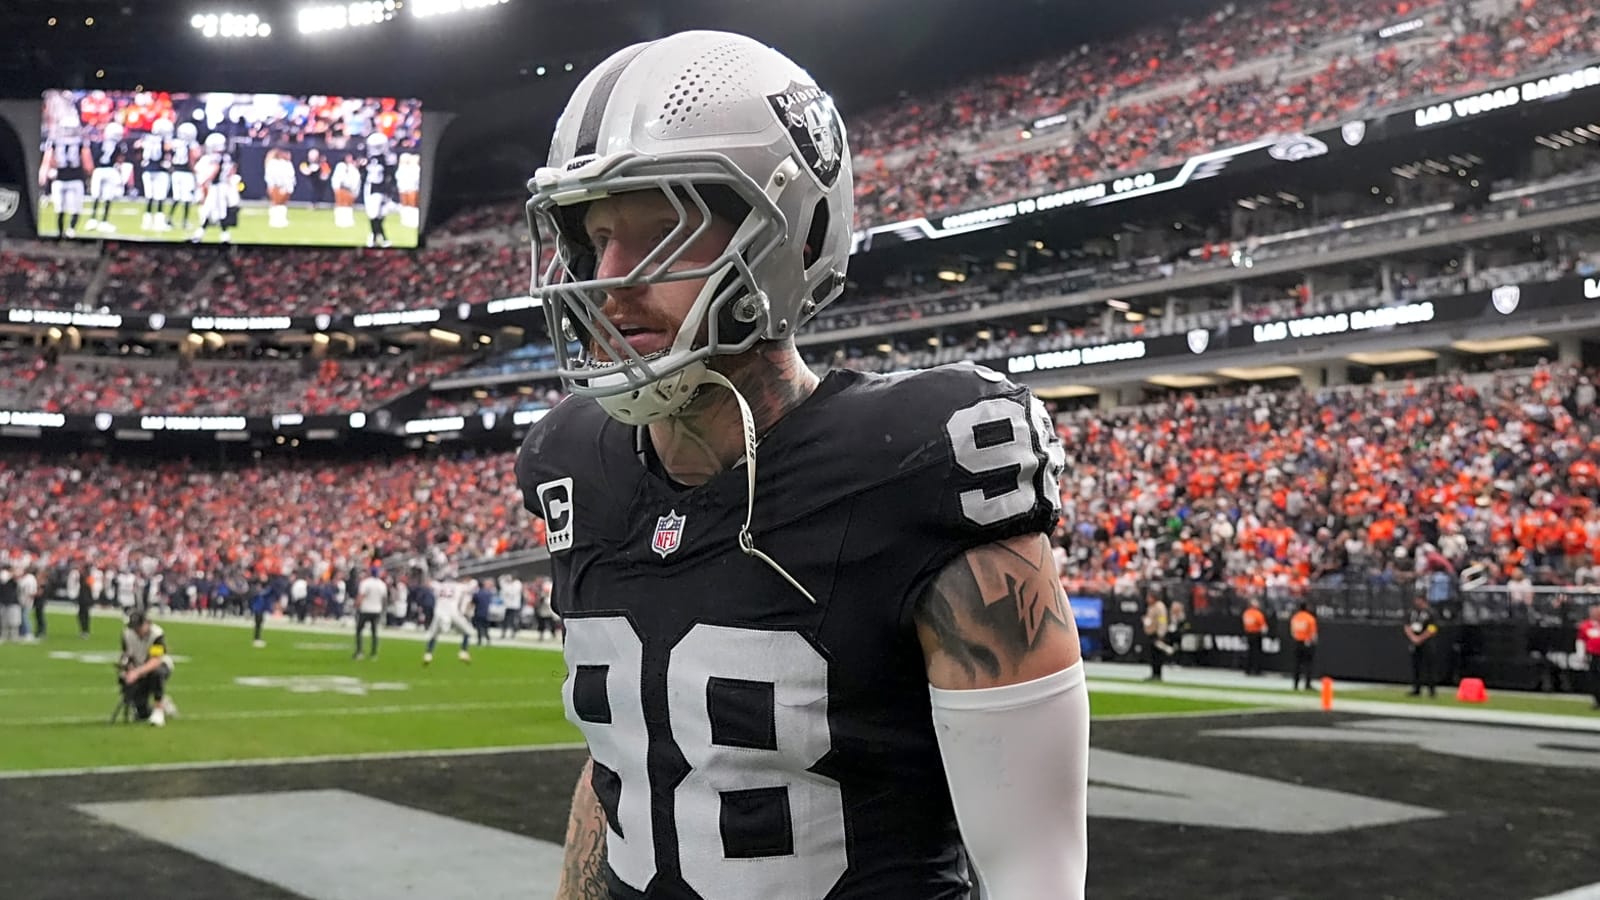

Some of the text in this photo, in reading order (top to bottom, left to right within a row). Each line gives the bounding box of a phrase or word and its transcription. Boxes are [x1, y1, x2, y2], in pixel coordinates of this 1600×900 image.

[542, 484, 569, 533] C
[656, 530, 677, 549] NFL
[562, 616, 849, 900] 98
